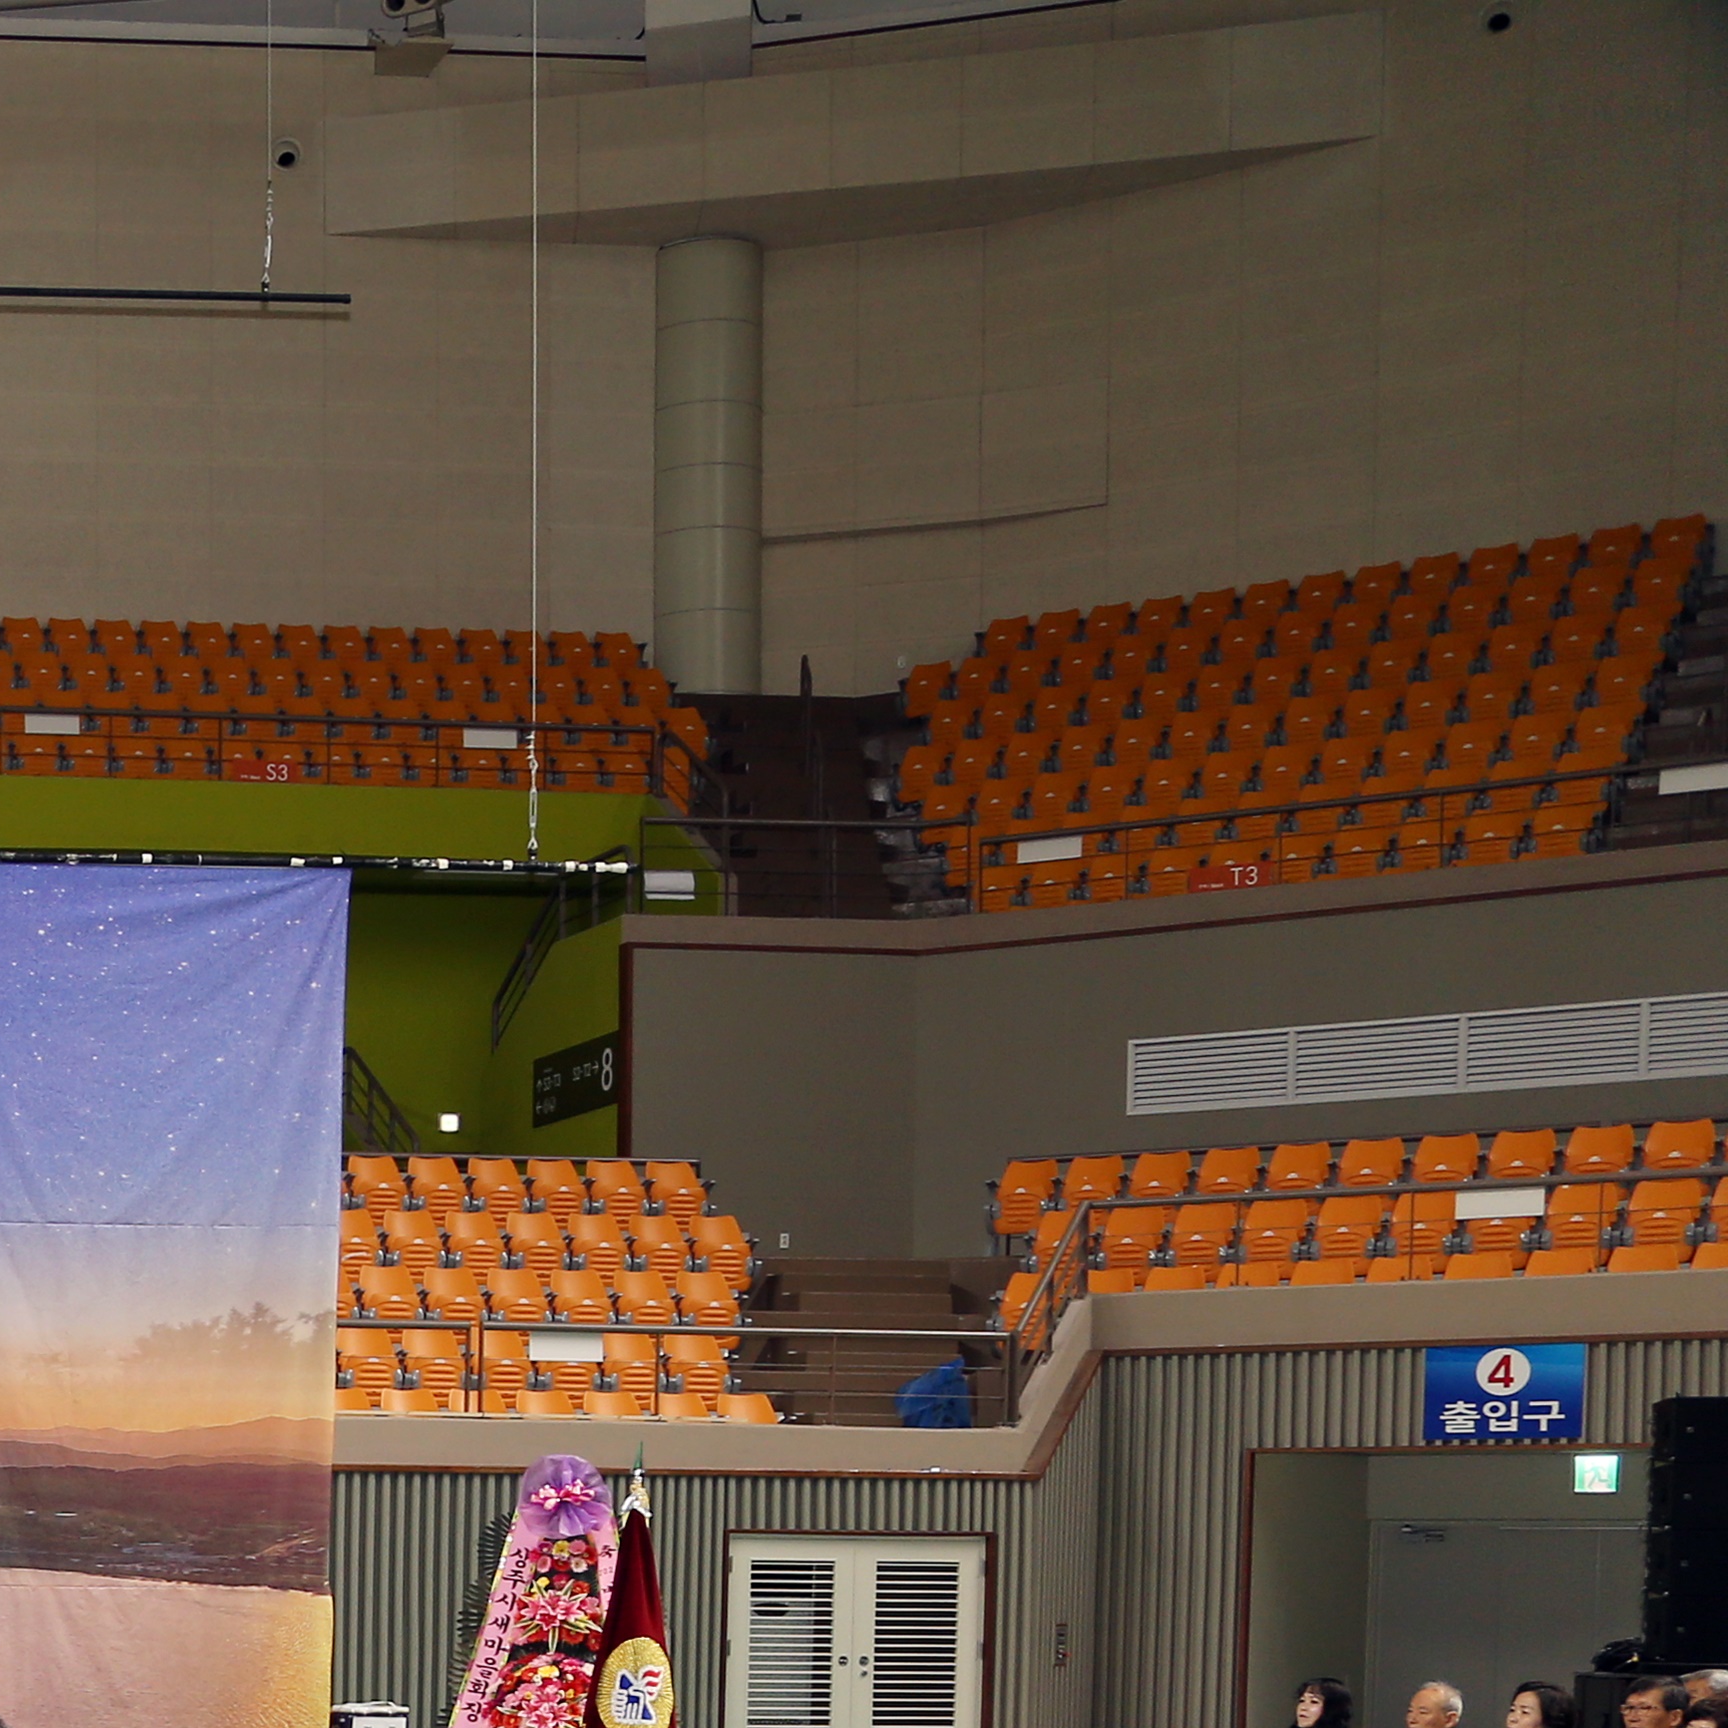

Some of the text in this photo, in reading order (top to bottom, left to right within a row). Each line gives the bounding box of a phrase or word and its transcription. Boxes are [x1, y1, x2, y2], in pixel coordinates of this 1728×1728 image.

[266, 763, 288, 781] S3
[1230, 866, 1258, 885] T3
[601, 1047, 613, 1091] 8
[1487, 1354, 1515, 1389] 4
[1440, 1400, 1565, 1434] 출입구
[462, 1547, 531, 1724] 상주시새마을회장
